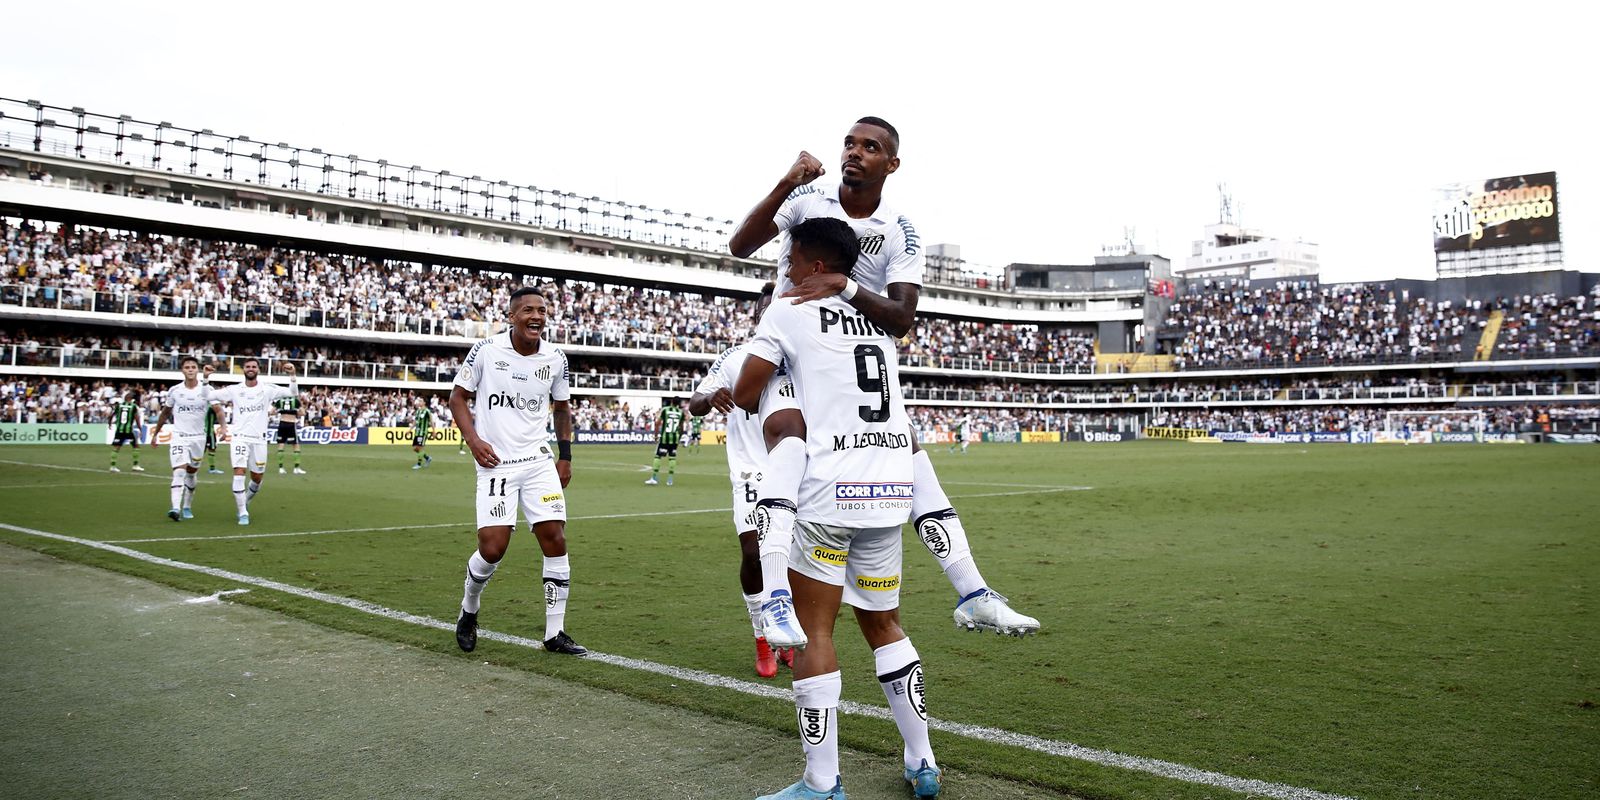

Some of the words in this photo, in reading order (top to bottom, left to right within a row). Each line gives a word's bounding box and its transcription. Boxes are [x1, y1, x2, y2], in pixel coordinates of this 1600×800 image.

[853, 344, 891, 423] 9
[489, 391, 544, 412] pixbet
[665, 418, 680, 433] 37
[1147, 428, 1209, 439] UNIASSELVI
[19, 430, 36, 442] do
[37, 428, 89, 442] Pitaco
[266, 426, 357, 445] stingbet
[385, 428, 458, 444] quazolit
[577, 431, 642, 442] BRASILEIRÃO
[1094, 432, 1122, 442] Bitso
[1356, 431, 1373, 443] Sil
[171, 445, 184, 455] 25
[235, 445, 247, 455] 92
[832, 435, 850, 452] M.
[488, 478, 507, 497] 11
[745, 481, 758, 503] 6
[837, 485, 871, 498] CORR
[872, 485, 914, 497] PLASTIK
[923, 524, 948, 555] Kodilar
[913, 670, 927, 714] Kodilar
[803, 707, 822, 739] Kodil
